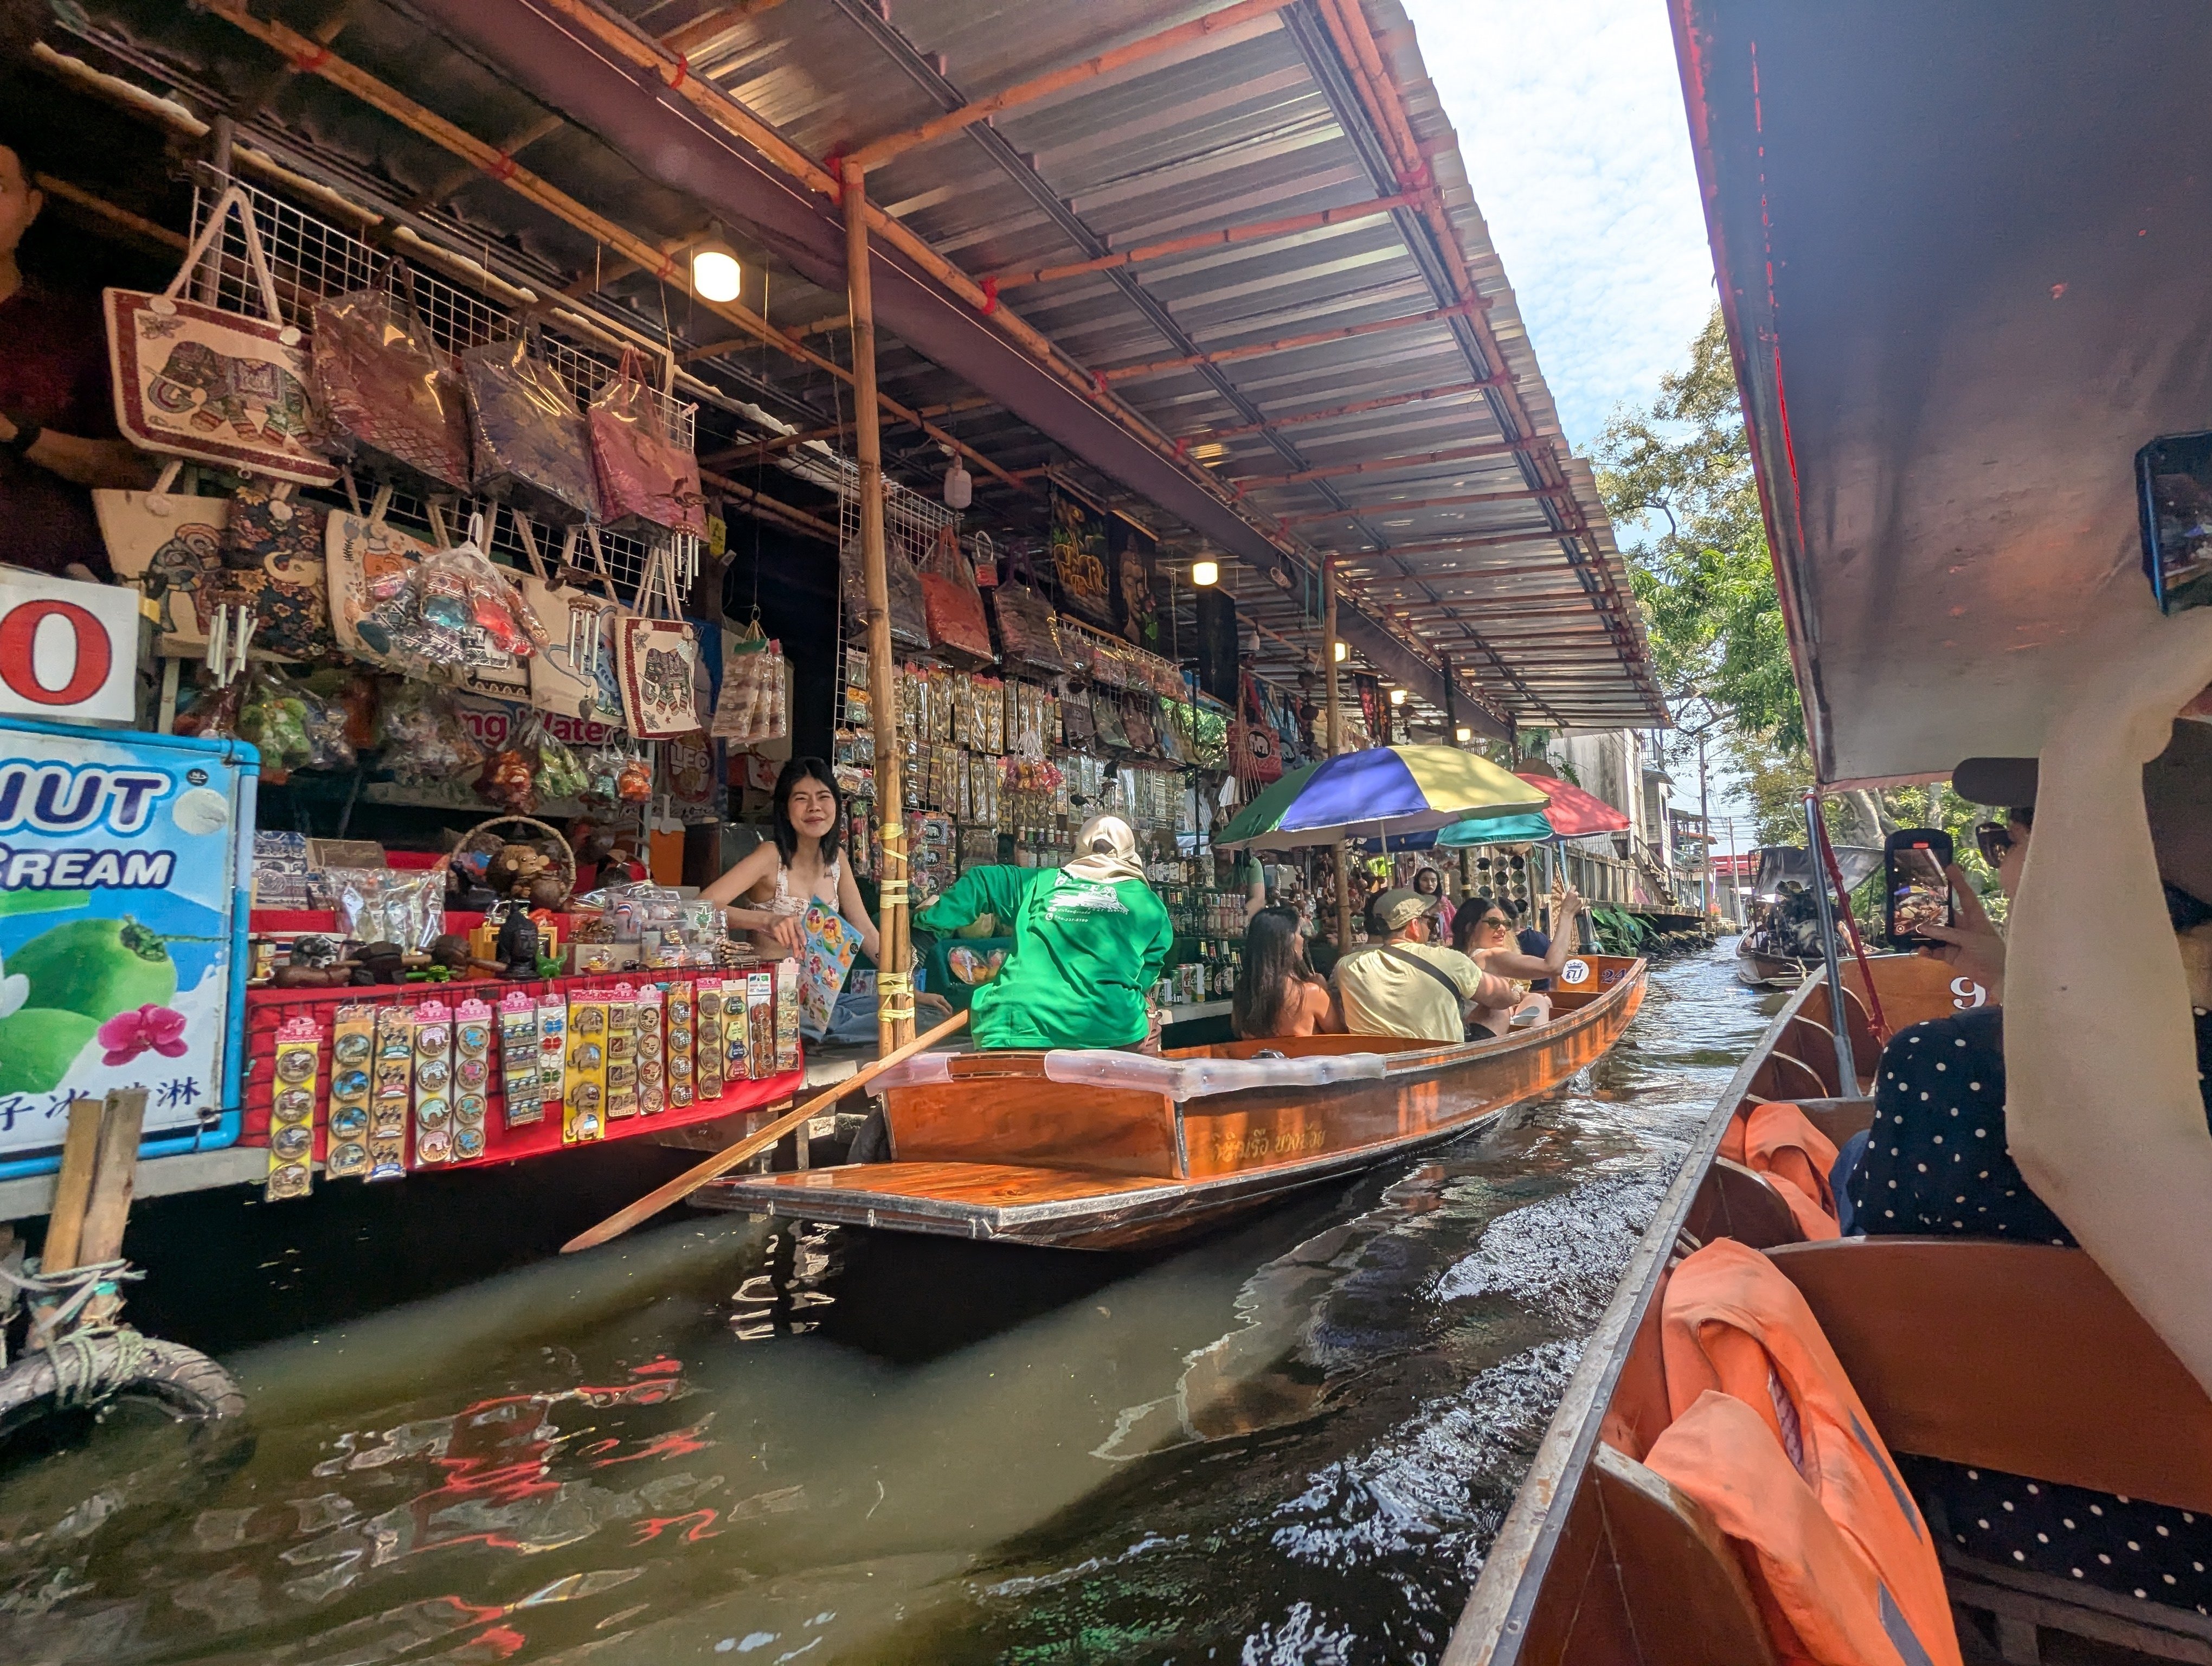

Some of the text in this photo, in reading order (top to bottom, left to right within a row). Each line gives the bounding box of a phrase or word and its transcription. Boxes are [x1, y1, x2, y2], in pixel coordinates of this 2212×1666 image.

[670, 743, 711, 775] LEO
[0, 853, 172, 887] REAM
[1950, 977, 1987, 1010] 9
[0, 1077, 201, 1131] 子淋
